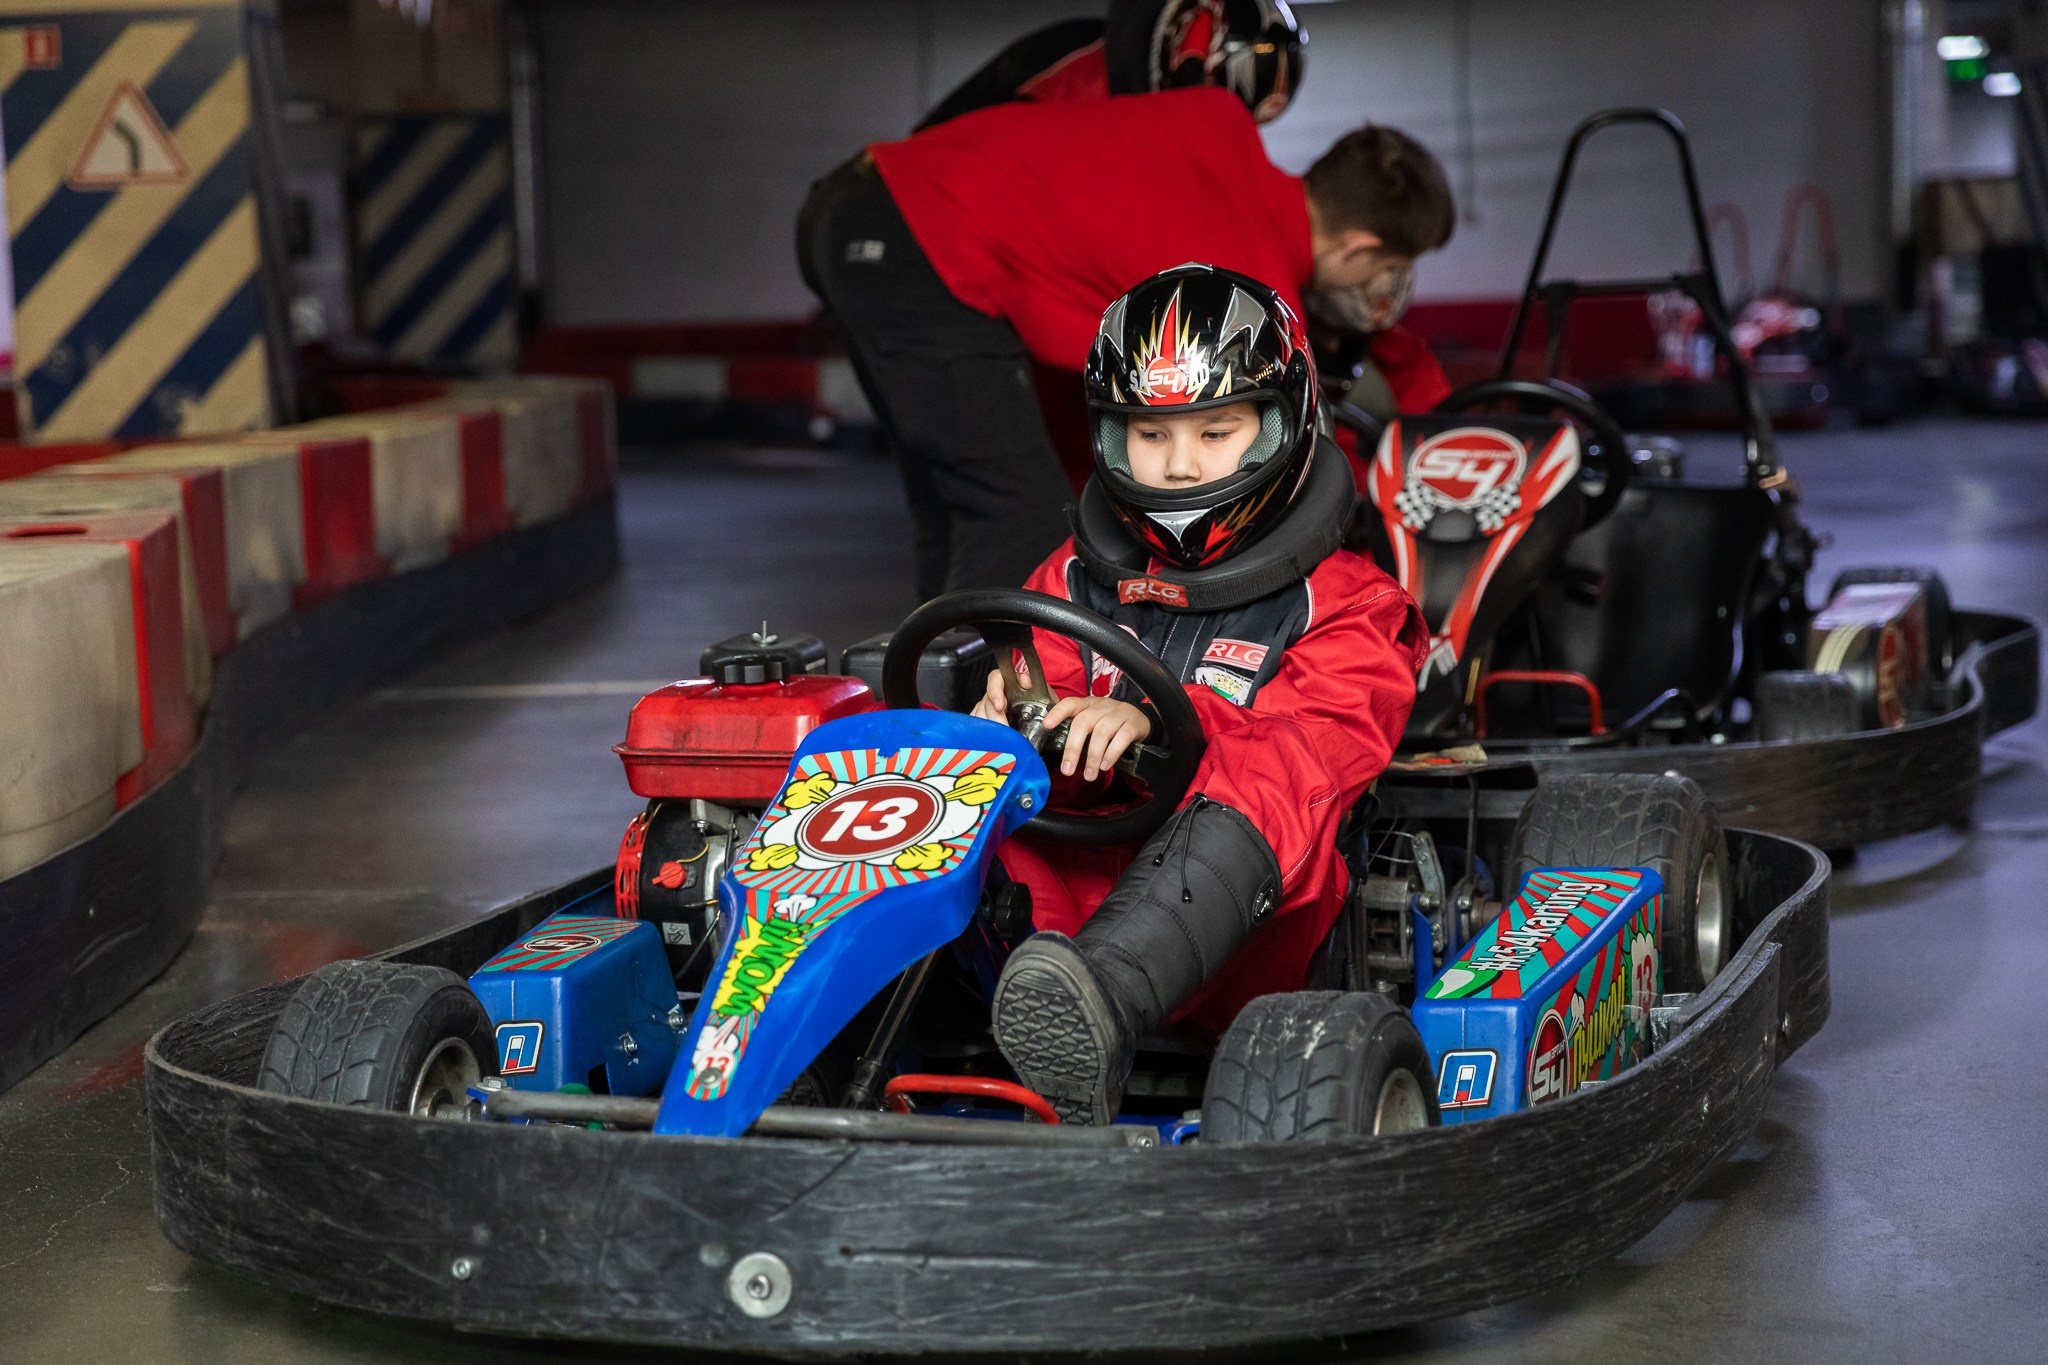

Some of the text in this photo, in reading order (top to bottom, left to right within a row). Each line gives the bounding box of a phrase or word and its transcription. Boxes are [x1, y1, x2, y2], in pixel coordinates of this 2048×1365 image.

[1125, 582, 1180, 599] RLG
[1205, 643, 1266, 665] RLG
[820, 796, 920, 843] 13
[1467, 881, 1608, 971] #k54karting
[1636, 954, 1653, 1018] 13
[705, 1056, 730, 1074] 13
